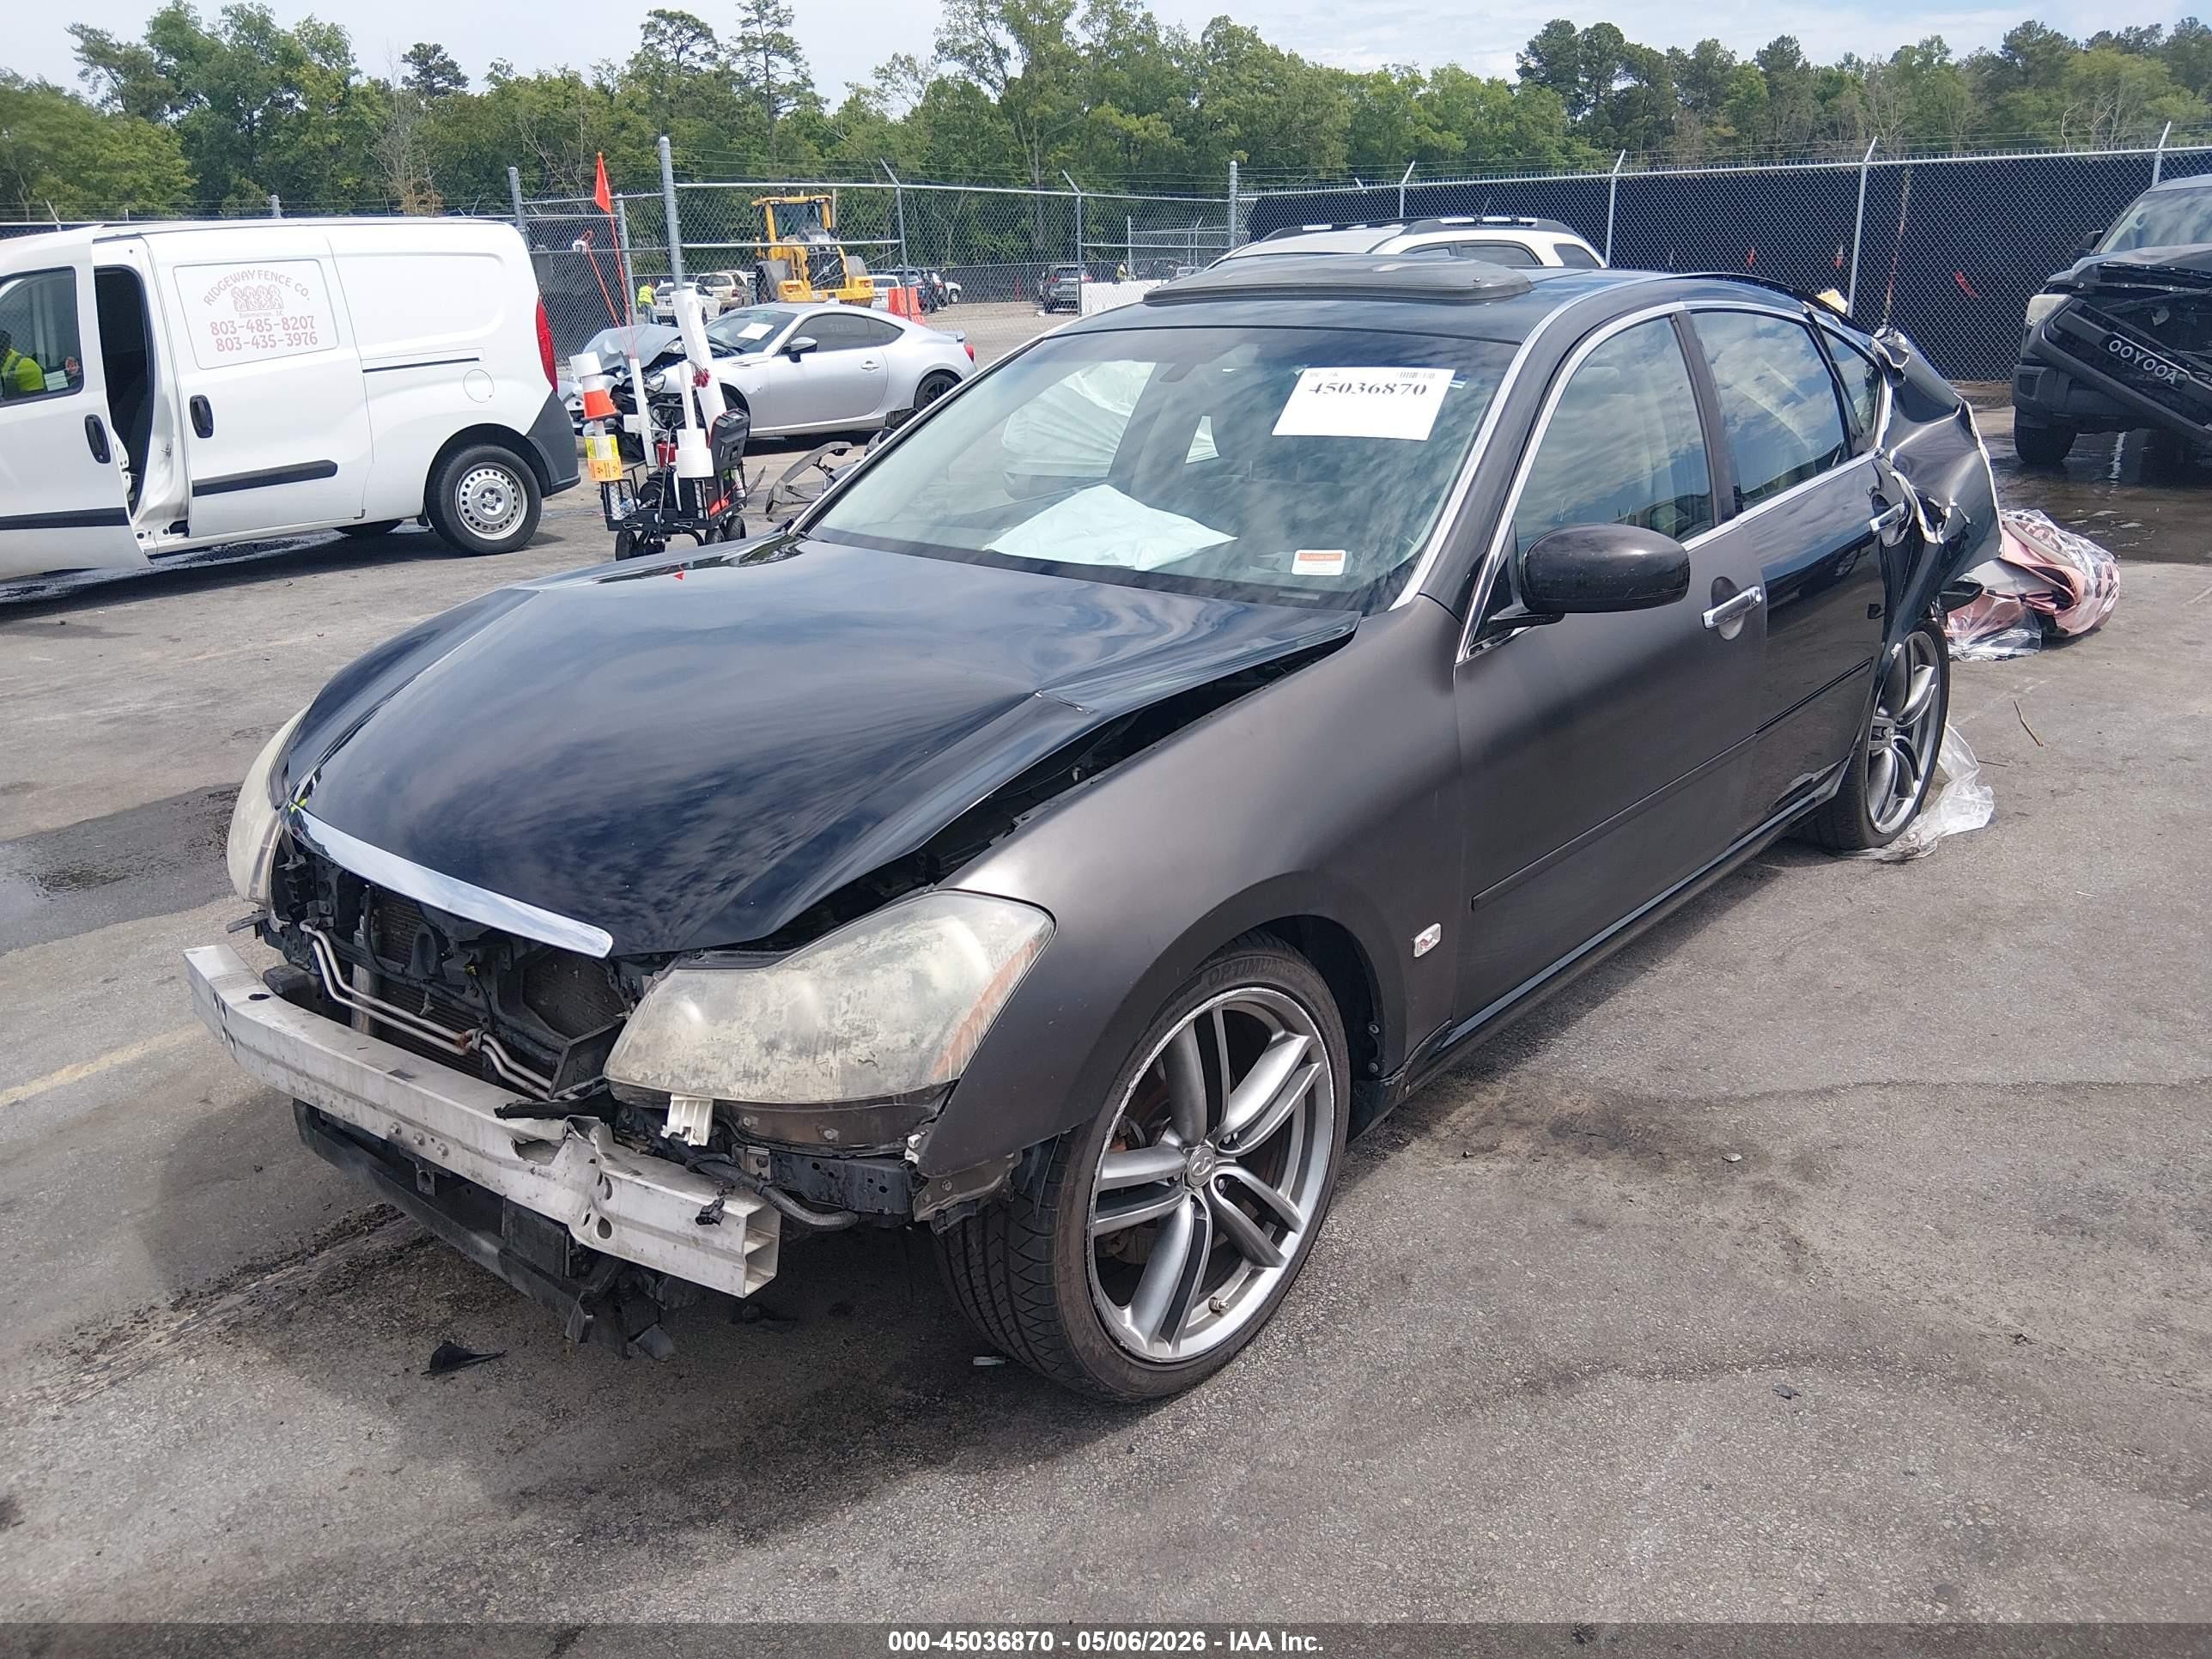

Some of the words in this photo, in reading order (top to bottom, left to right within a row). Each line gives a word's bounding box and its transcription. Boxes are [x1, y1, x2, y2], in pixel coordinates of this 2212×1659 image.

[204, 270, 256, 307] RIDGEWAY
[258, 270, 293, 288] FENCE
[295, 283, 310, 301] CO.
[210, 315, 315, 336] 803-485-8207
[216, 331, 319, 352] 803-435-3976
[1308, 381, 1428, 395] 45036870
